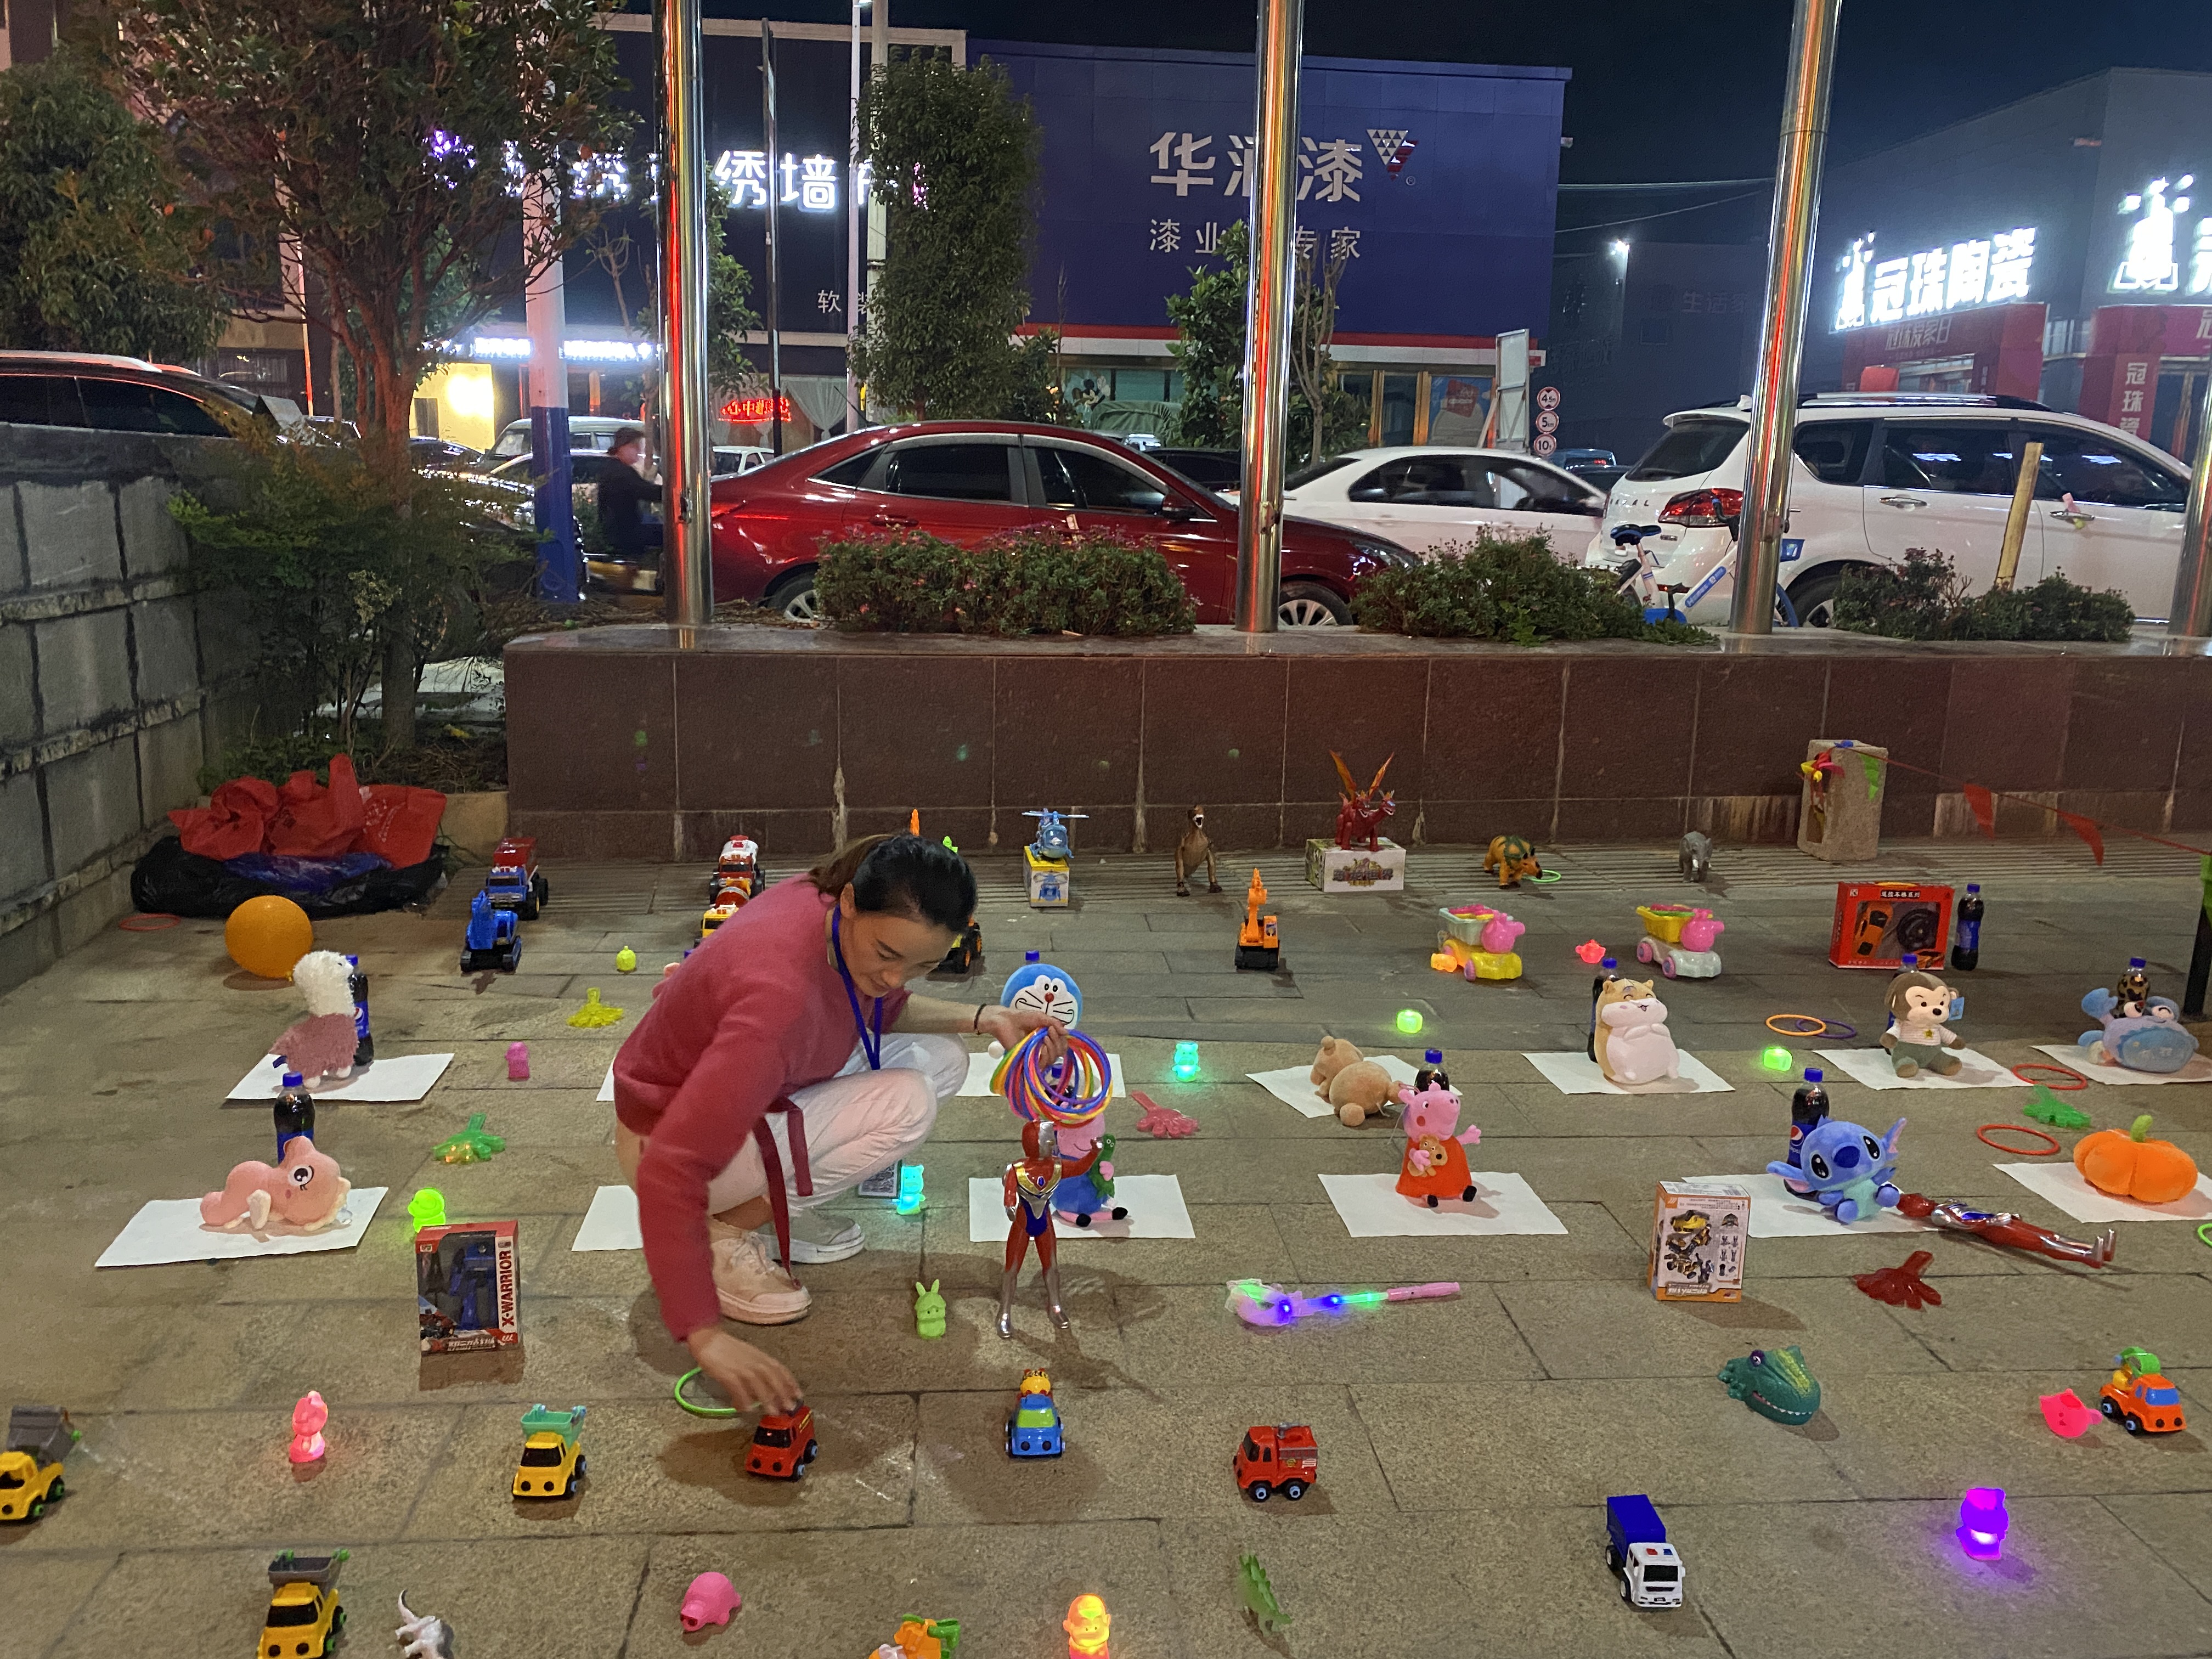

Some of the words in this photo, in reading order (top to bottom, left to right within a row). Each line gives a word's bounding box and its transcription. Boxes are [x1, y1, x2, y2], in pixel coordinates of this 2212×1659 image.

[1149, 218, 1361, 259] 漆业专家
[1870, 227, 2036, 323] 冠珠陶瓷
[499, 1250, 515, 1327] X-WARRIOR
